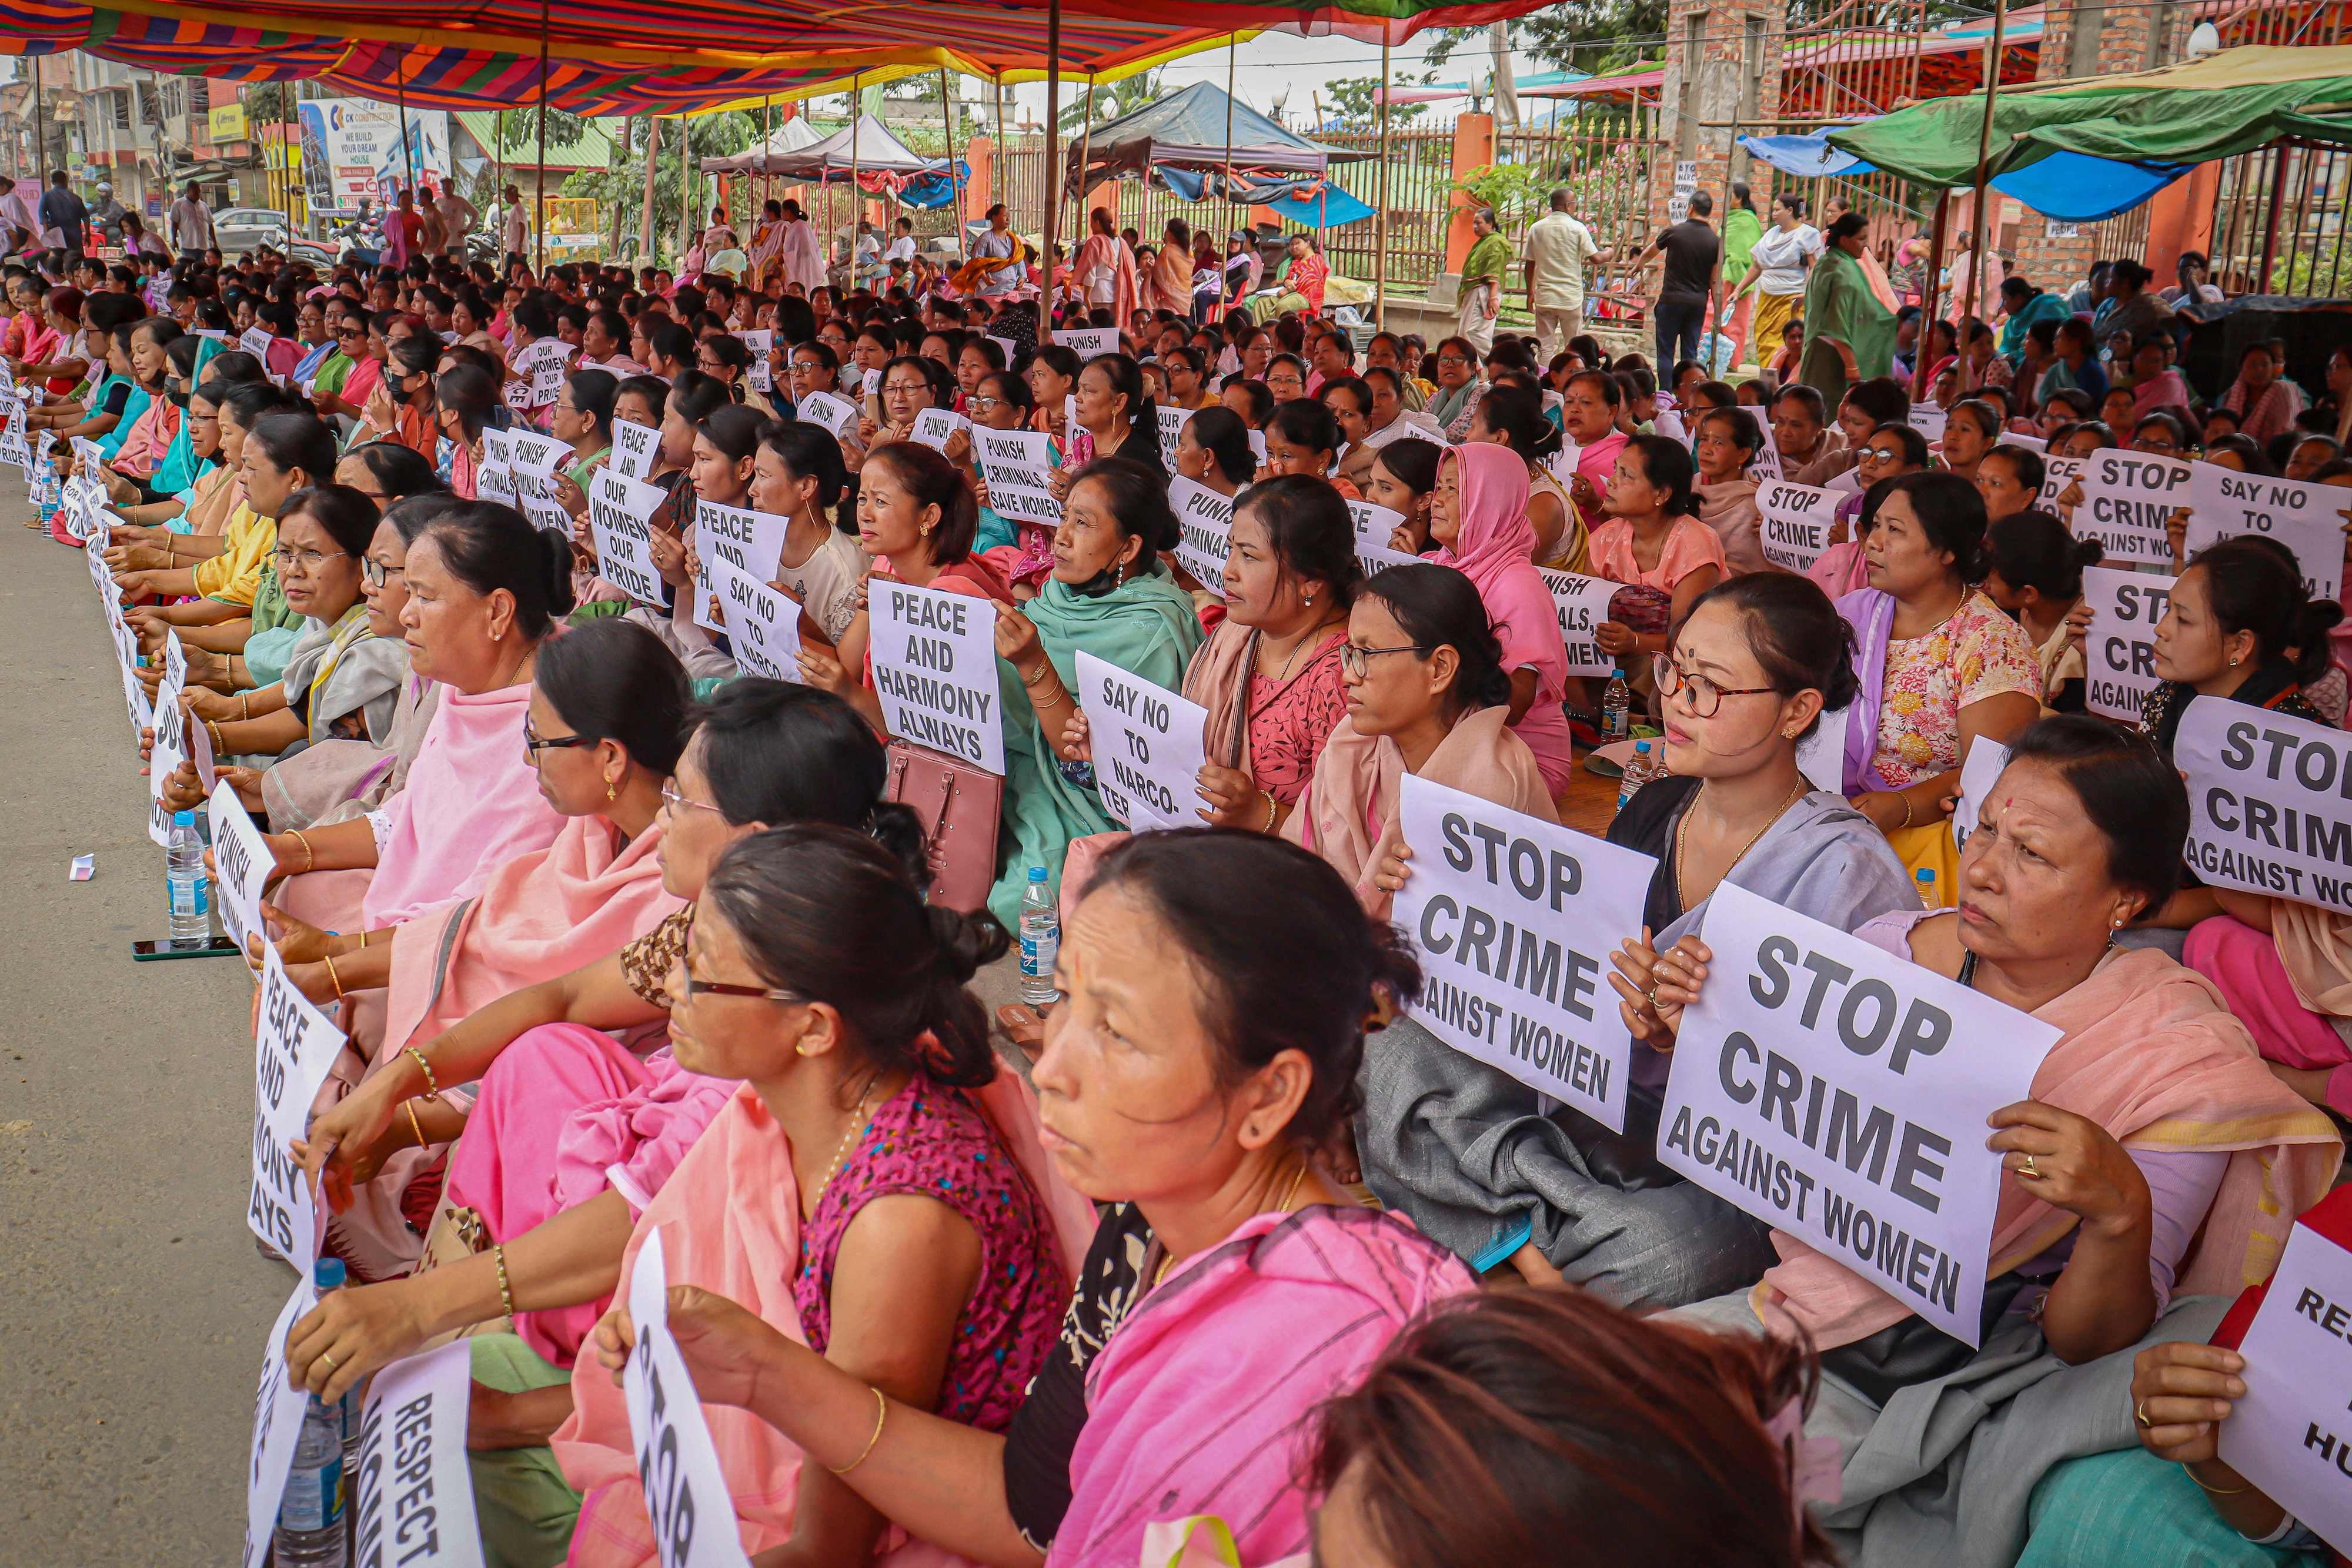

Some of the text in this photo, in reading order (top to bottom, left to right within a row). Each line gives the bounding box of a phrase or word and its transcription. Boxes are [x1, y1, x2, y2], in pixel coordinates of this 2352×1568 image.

[346, 112, 395, 123] CK CONSTRUCTION
[340, 143, 377, 153] YOUR DREAM
[345, 132, 372, 142] WE BUILD
[350, 155, 370, 164] HOUSE
[537, 345, 553, 357] OUR
[747, 337, 759, 347] OUR
[752, 349, 769, 361] OMEN
[1067, 335, 1101, 350] PUNISH
[530, 356, 565, 375] WOMEN
[545, 373, 558, 385] OUR
[537, 385, 561, 403] PRIDE
[750, 376, 766, 389] PRIDE
[807, 397, 835, 424] PUNISH
[1157, 412, 1180, 429] OUR
[622, 426, 649, 455] PEACE
[923, 416, 949, 440] PUNISH
[0, 447, 24, 464] RIDE
[515, 439, 550, 466] PUNISH
[985, 437, 1027, 462] PUNISH
[619, 456, 636, 478] AND
[2102, 458, 2192, 491] STOP
[64, 485, 78, 500] FOR
[604, 478, 627, 506] OUR
[990, 490, 1060, 519] SAVE WOMEN
[1185, 492, 1234, 524] PUNIS
[1769, 486, 1822, 513] STOP
[2221, 477, 2308, 509] SAY NO
[592, 497, 650, 543] WOMEN
[699, 506, 754, 544] PEACE
[1768, 517, 1822, 549] CRIME
[2243, 509, 2273, 532] TO
[609, 536, 635, 563] OUR
[1181, 522, 1228, 560] RIMINAL
[1764, 546, 1796, 568] AGAINST
[603, 556, 655, 601] PRIDE
[730, 576, 775, 623] SAY NO
[891, 591, 967, 637] PEACE
[745, 617, 764, 646] TO
[906, 634, 954, 673] AND
[876, 665, 991, 724] HARMONY
[1102, 677, 1170, 735] SAY NO
[2090, 680, 2144, 713] AGAIN
[898, 707, 983, 761] ALWAYS
[1124, 728, 1150, 766] TO
[1112, 757, 1180, 817] NARCO-
[2206, 787, 2352, 867] CRIM
[216, 815, 252, 901] PUNISH
[1441, 813, 1583, 914] STOP
[2186, 837, 2303, 896] AGAINST
[1419, 894, 1599, 1023] CRIME
[266, 965, 310, 1067] PEACE
[1748, 935, 1953, 1076] STOP
[1418, 977, 1612, 1104] AINST WOMEN
[259, 1037, 285, 1112] AND
[1718, 1031, 1952, 1215] CRIME
[250, 1178, 293, 1256] AYS
[1666, 1105, 1962, 1316] AGAINST WOMEN
[395, 1392, 439, 1568] RESPECT
